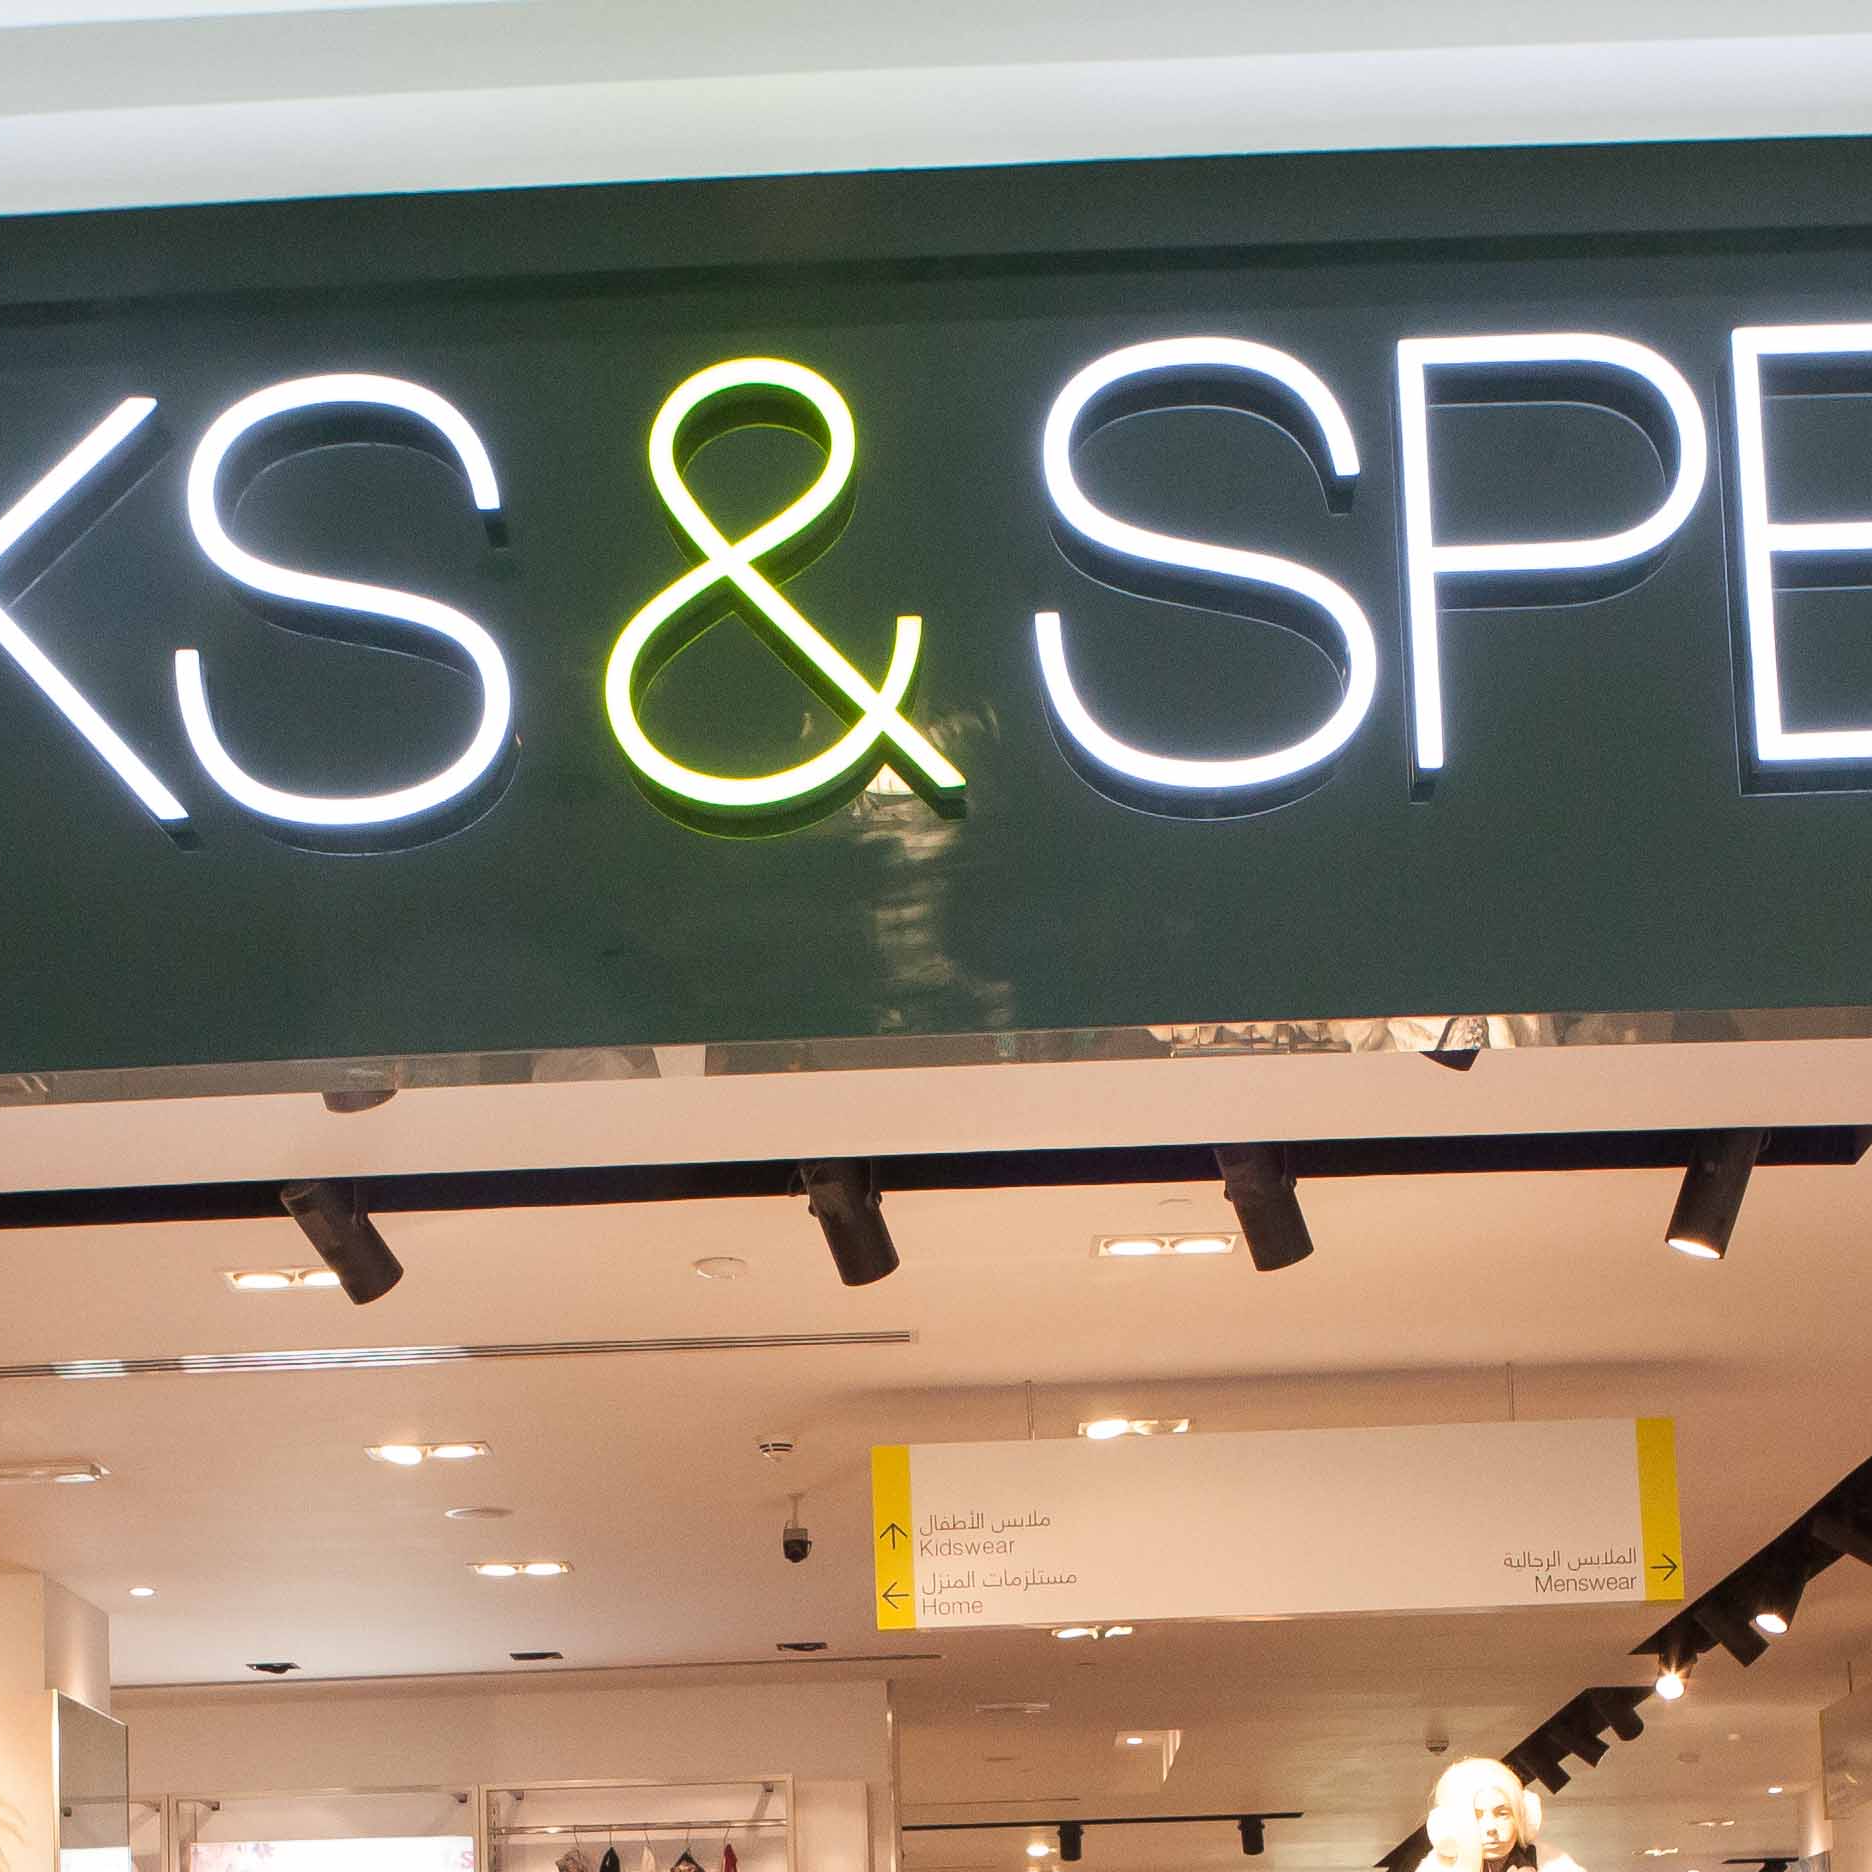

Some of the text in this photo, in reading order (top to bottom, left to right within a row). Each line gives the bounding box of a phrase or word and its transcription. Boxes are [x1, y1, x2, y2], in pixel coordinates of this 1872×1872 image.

[602, 354, 969, 808] &
[919, 1509, 1052, 1536] ملابس الأطفال
[919, 1538, 1016, 1557] Kidswear
[1503, 1547, 1638, 1573] الملابس الرجالية
[921, 1568, 1079, 1595] مستلزمات المنزل
[1534, 1574, 1638, 1593] Menswear
[921, 1599, 984, 1616] Home
